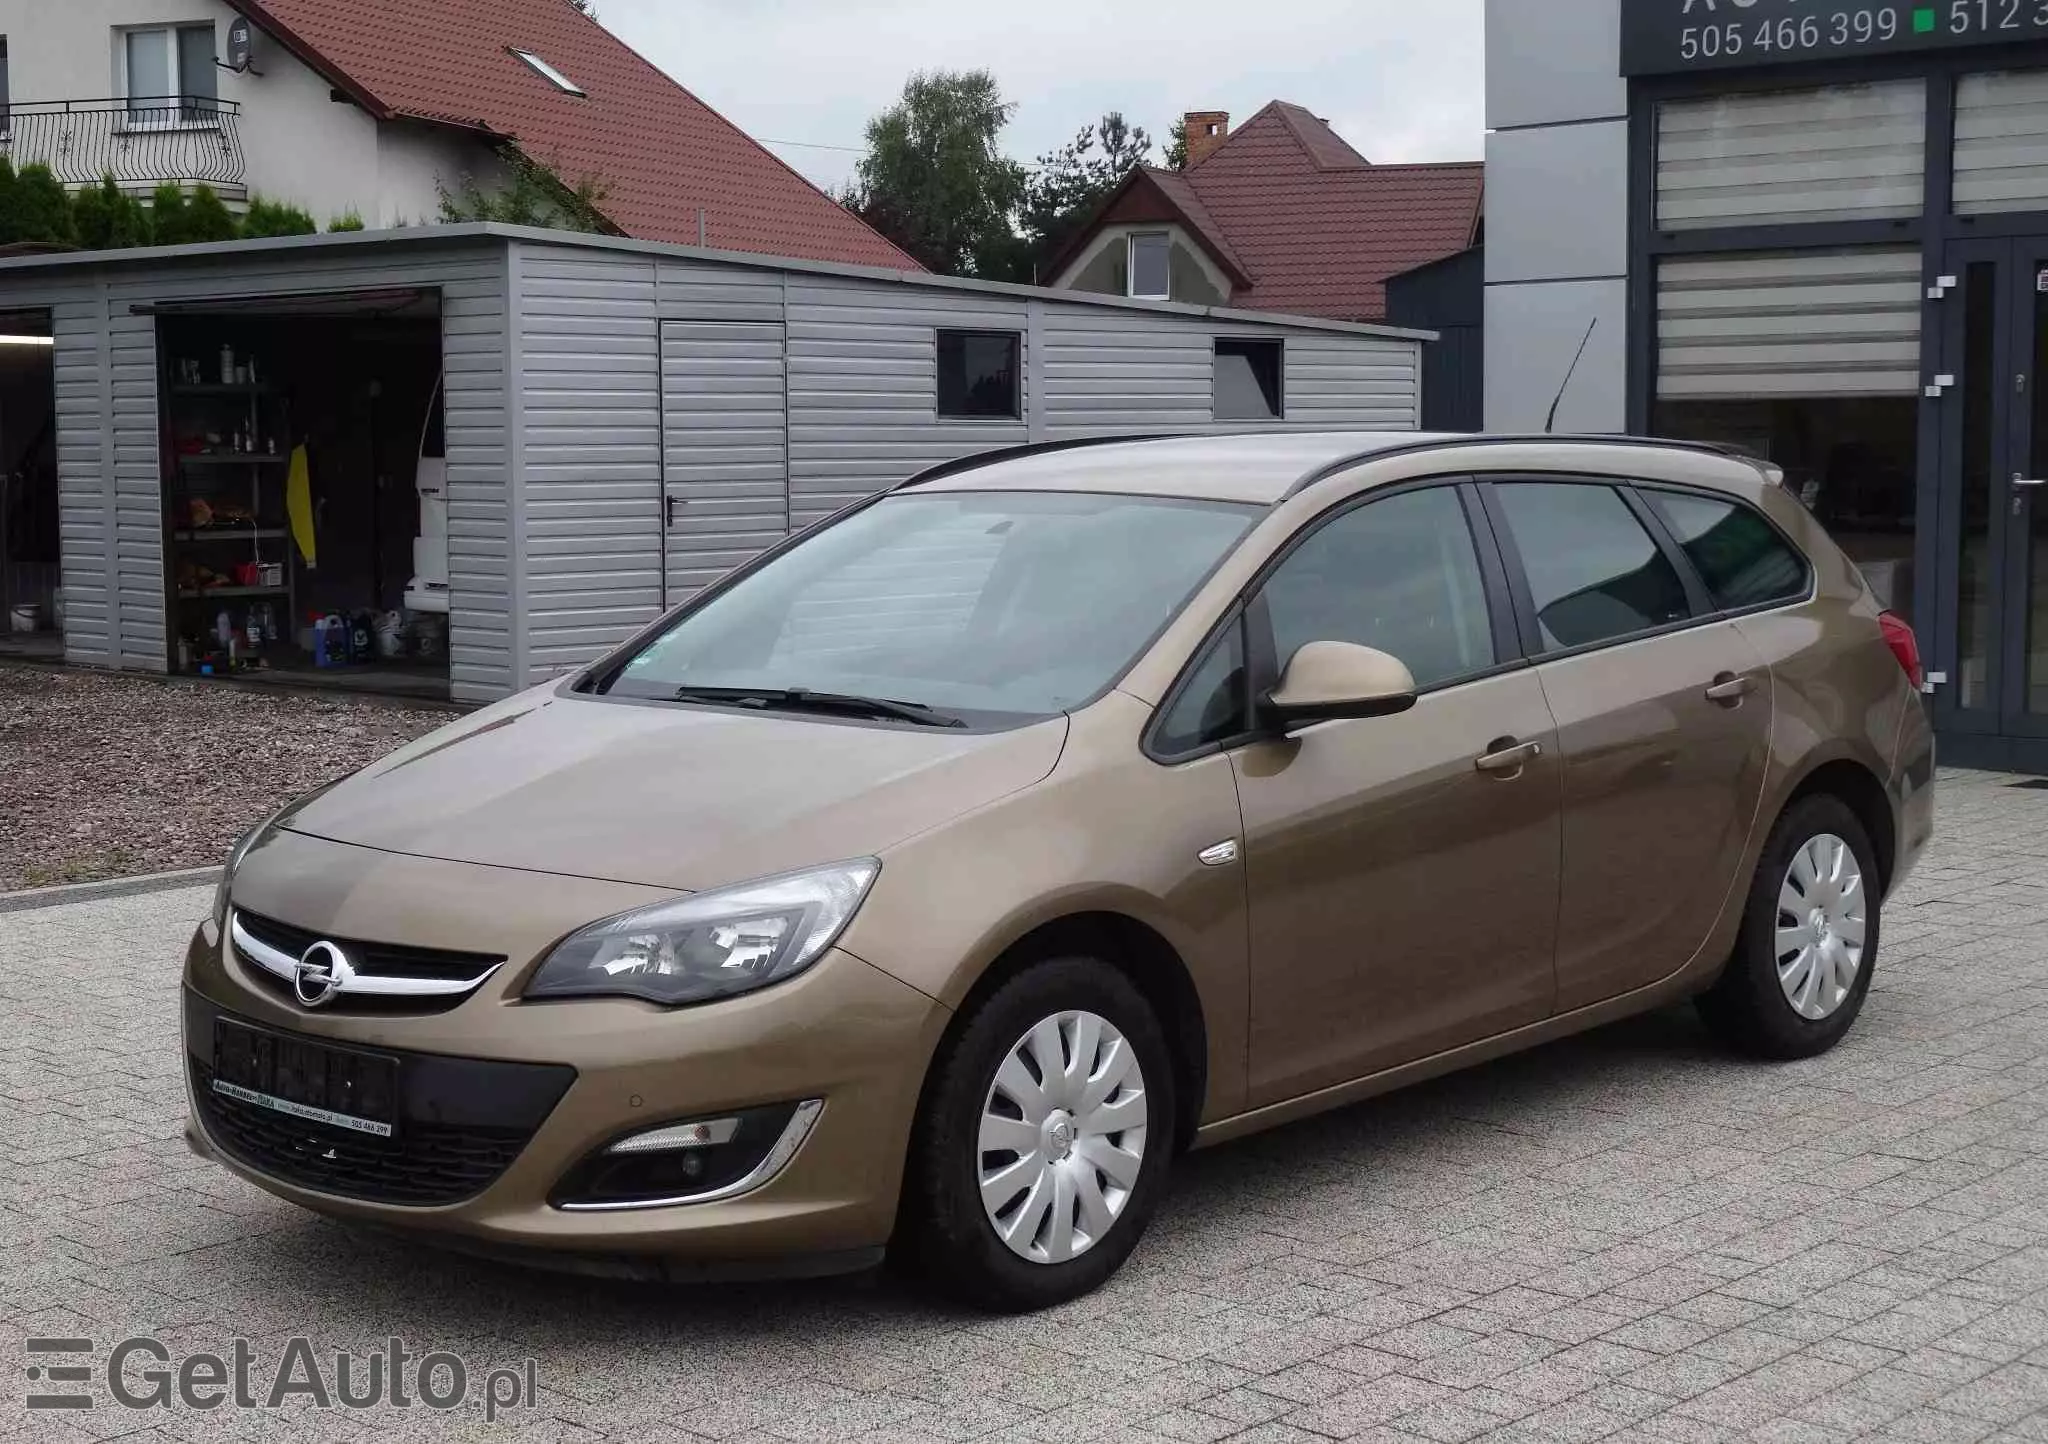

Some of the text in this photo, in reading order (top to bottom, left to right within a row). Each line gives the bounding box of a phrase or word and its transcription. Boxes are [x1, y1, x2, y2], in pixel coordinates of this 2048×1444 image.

[1680, 22, 1742, 59] 505
[1752, 15, 1819, 51] 466
[1829, 7, 1898, 46] 399
[1950, 0, 2020, 33] 512
